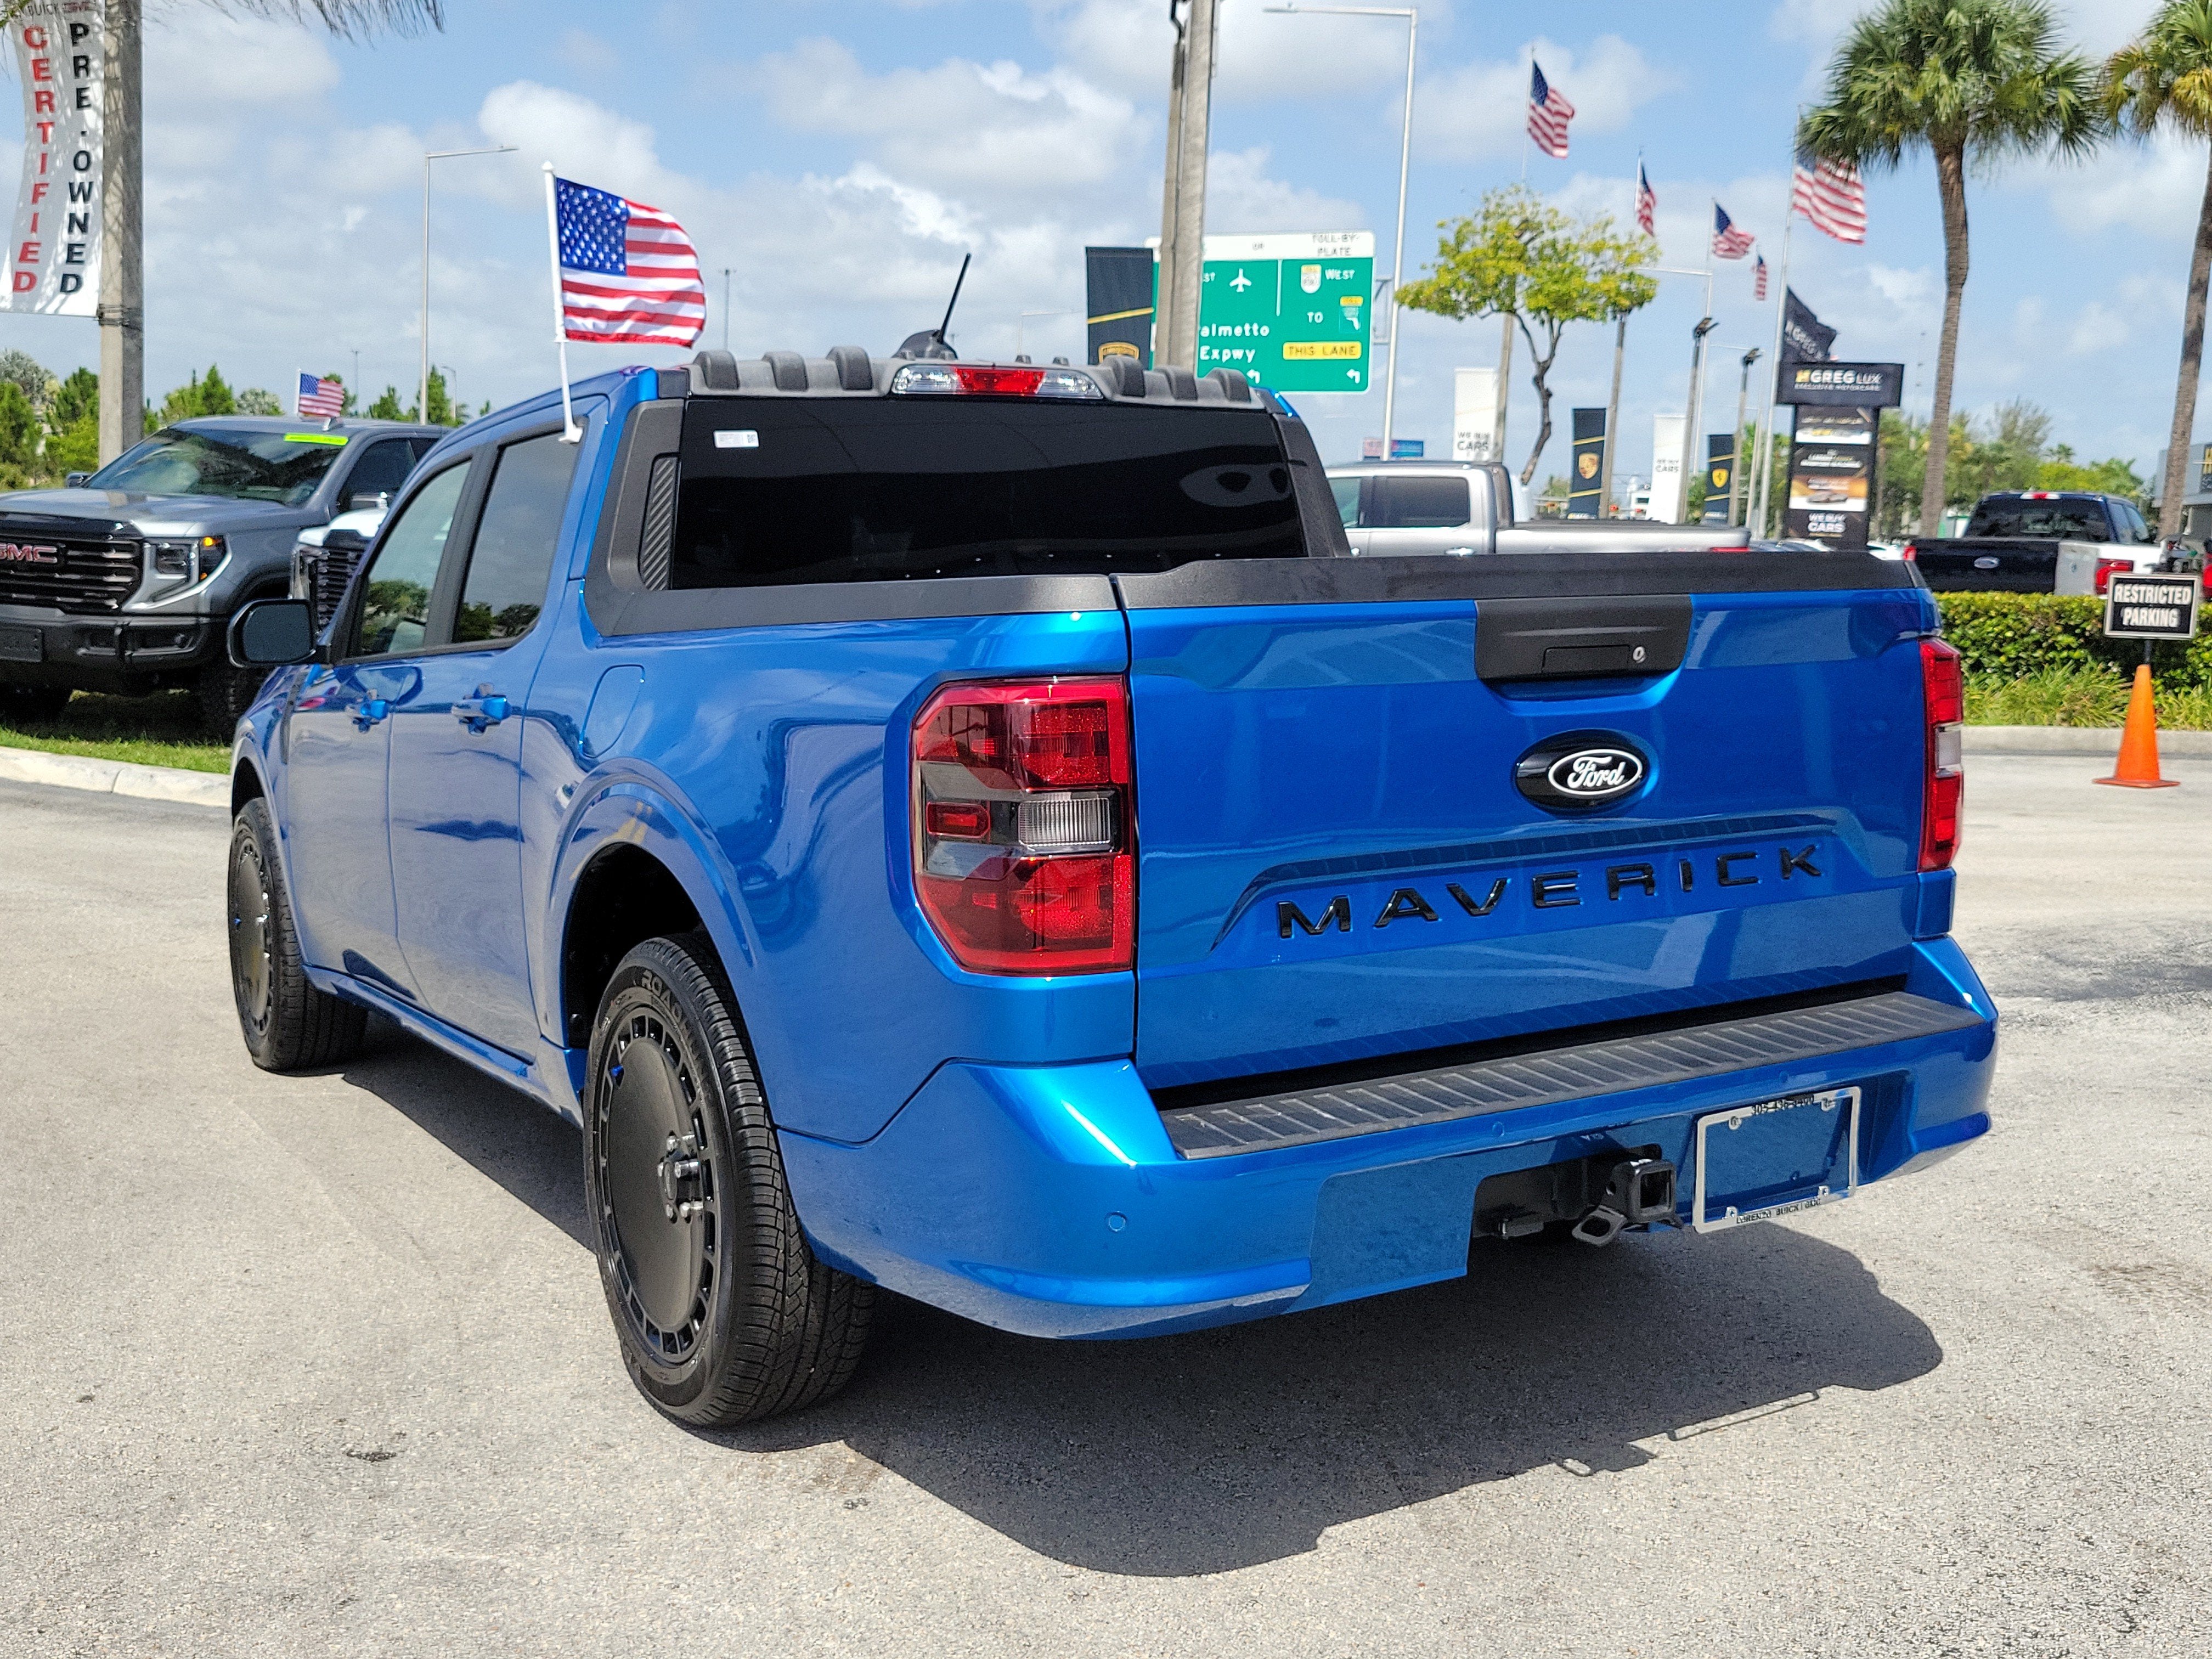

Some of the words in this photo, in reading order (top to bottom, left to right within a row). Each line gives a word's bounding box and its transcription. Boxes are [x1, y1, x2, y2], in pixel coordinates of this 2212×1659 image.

[13, 25, 55, 294] CERTIFIED
[1317, 247, 1352, 257] PLATE
[1325, 269, 1355, 280] WEST
[1307, 312, 1324, 323] TO
[1199, 323, 1269, 337] almetto
[1200, 345, 1256, 363] Expwy
[1289, 346, 1314, 356] THIS
[1322, 346, 1357, 356] LANE
[1457, 441, 1489, 452] CARS
[1808, 522, 1846, 533] CARS
[0, 542, 58, 564] MC
[2114, 584, 2192, 605] RESTRICTED
[2123, 607, 2180, 628] PARKING
[1567, 756, 1627, 788] Ford
[1278, 844, 1824, 939] MAVERICK
[1736, 1210, 1771, 1224] LORENZO
